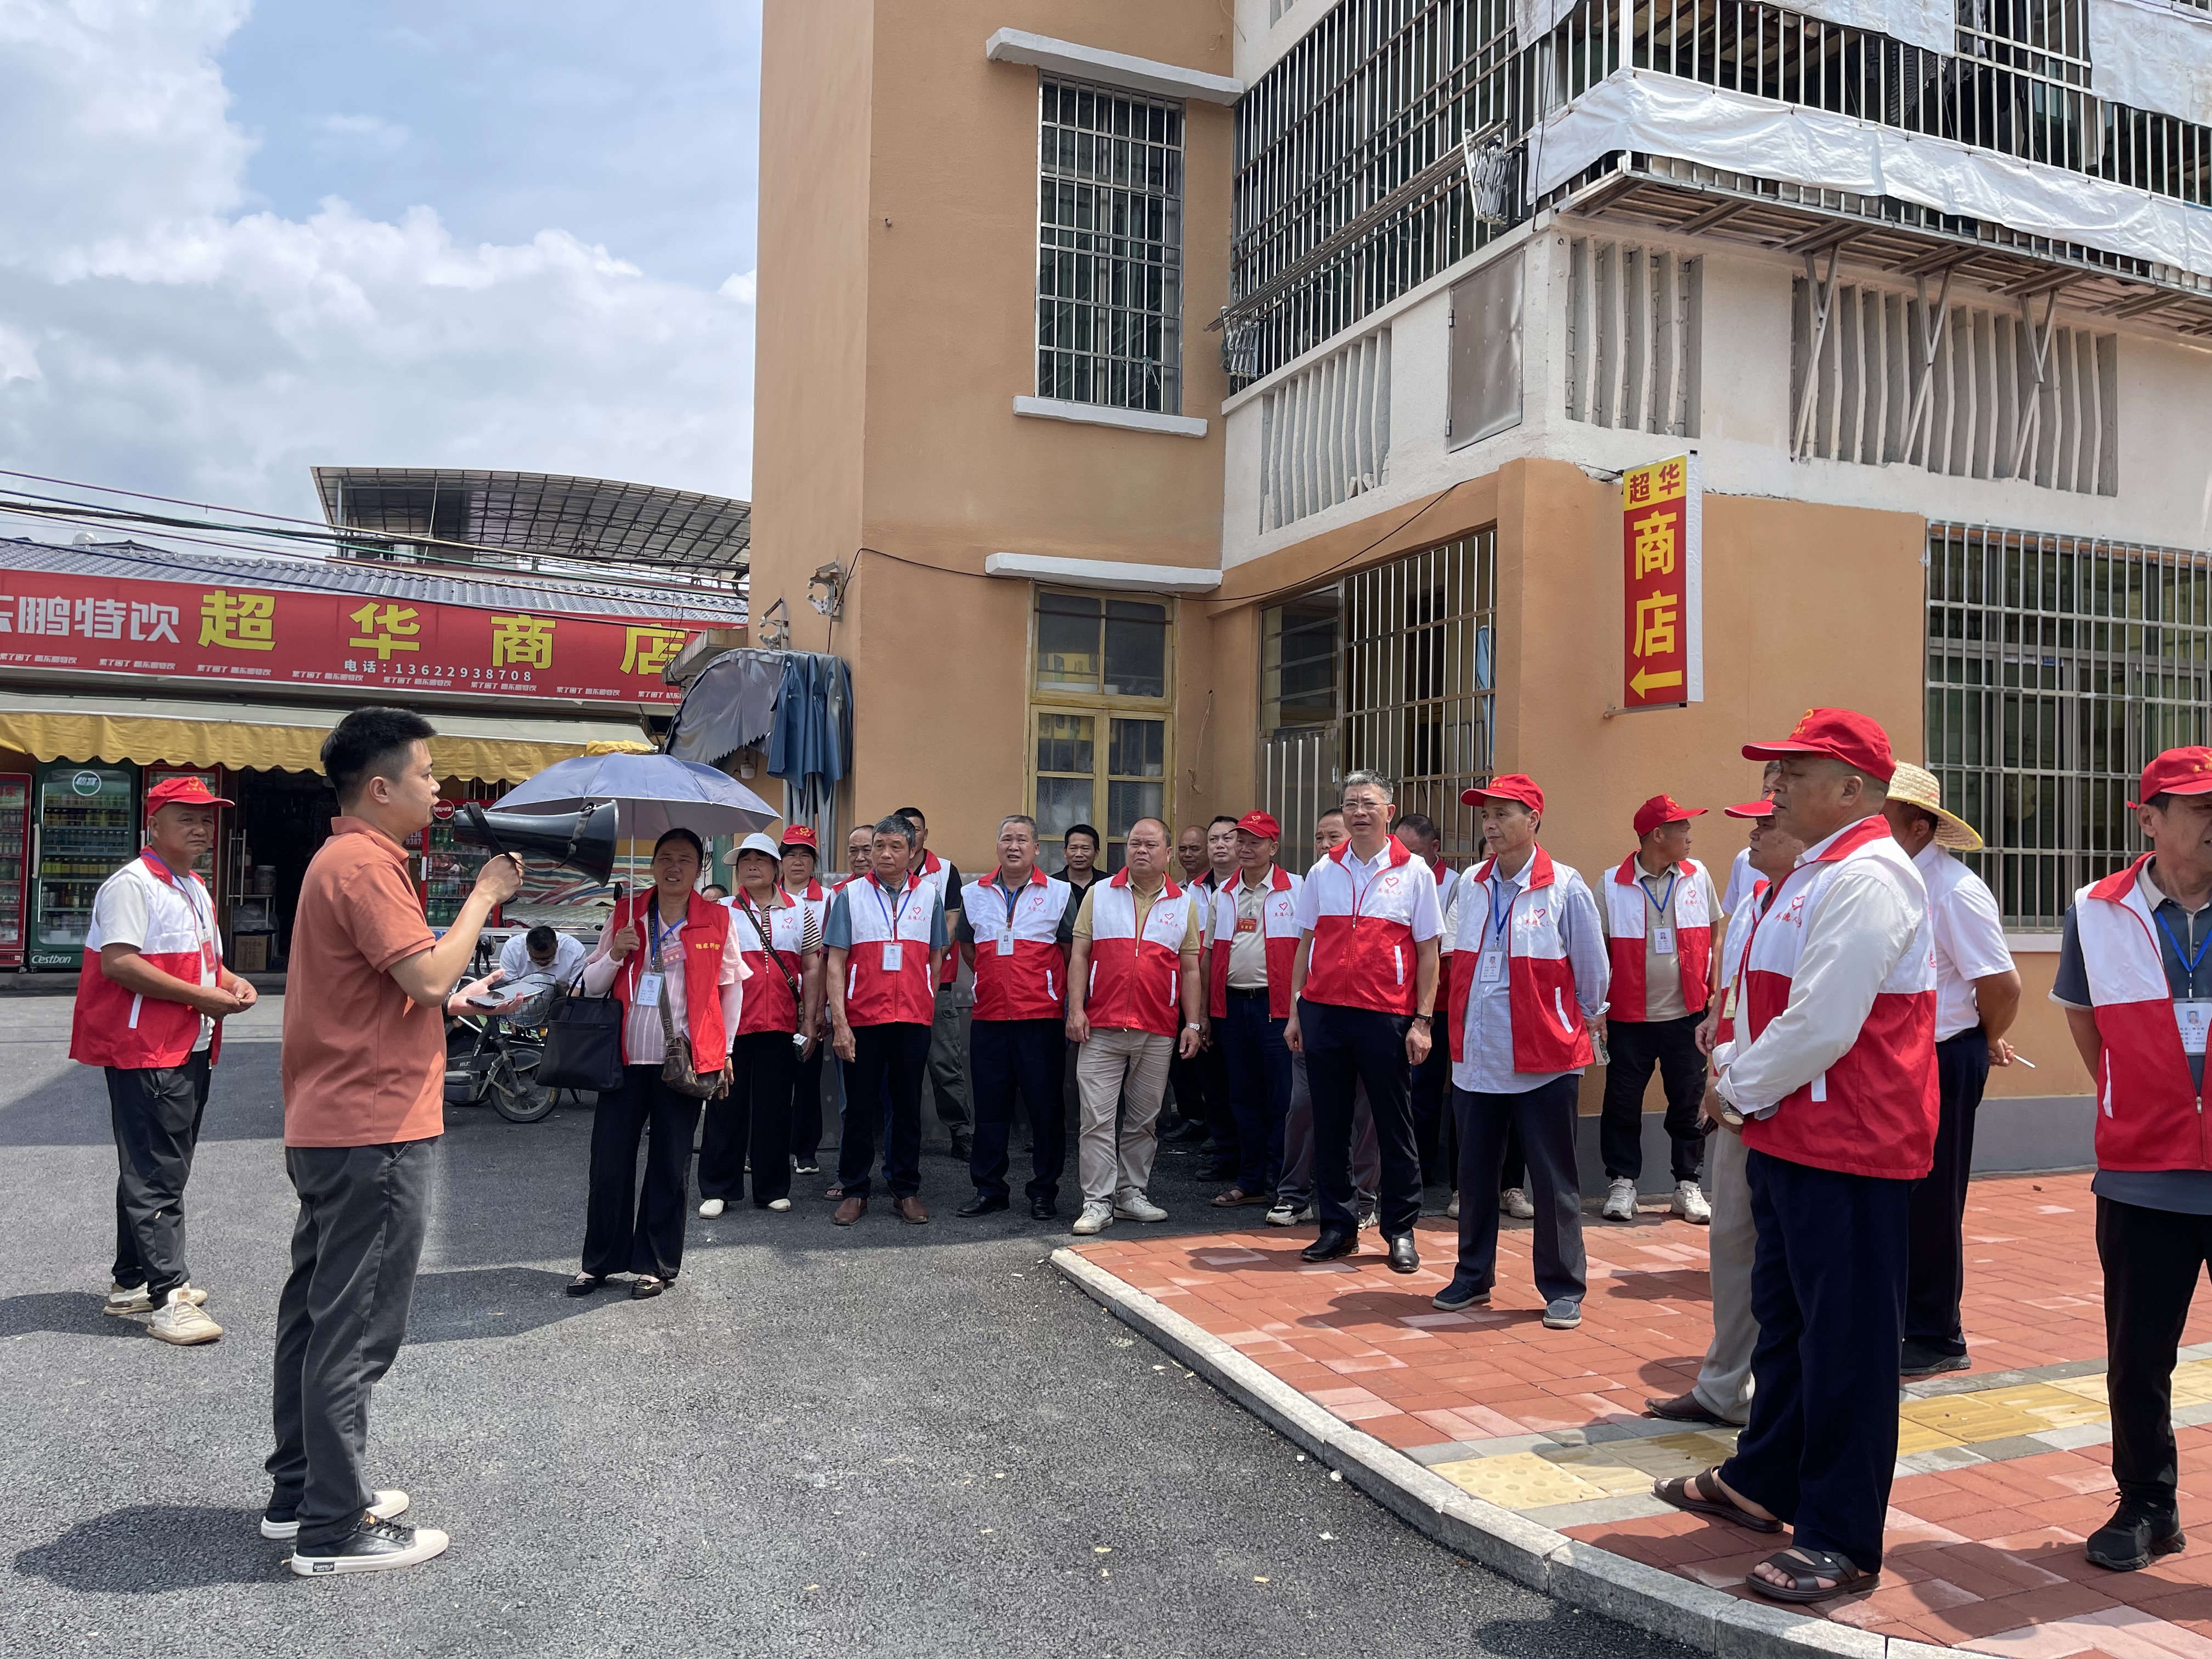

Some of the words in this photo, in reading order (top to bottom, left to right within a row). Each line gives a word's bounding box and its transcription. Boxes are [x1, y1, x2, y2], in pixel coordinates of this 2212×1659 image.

[1629, 463, 1679, 504] 超华
[1633, 510, 1677, 658] 商店
[197, 590, 686, 675] 超华商店
